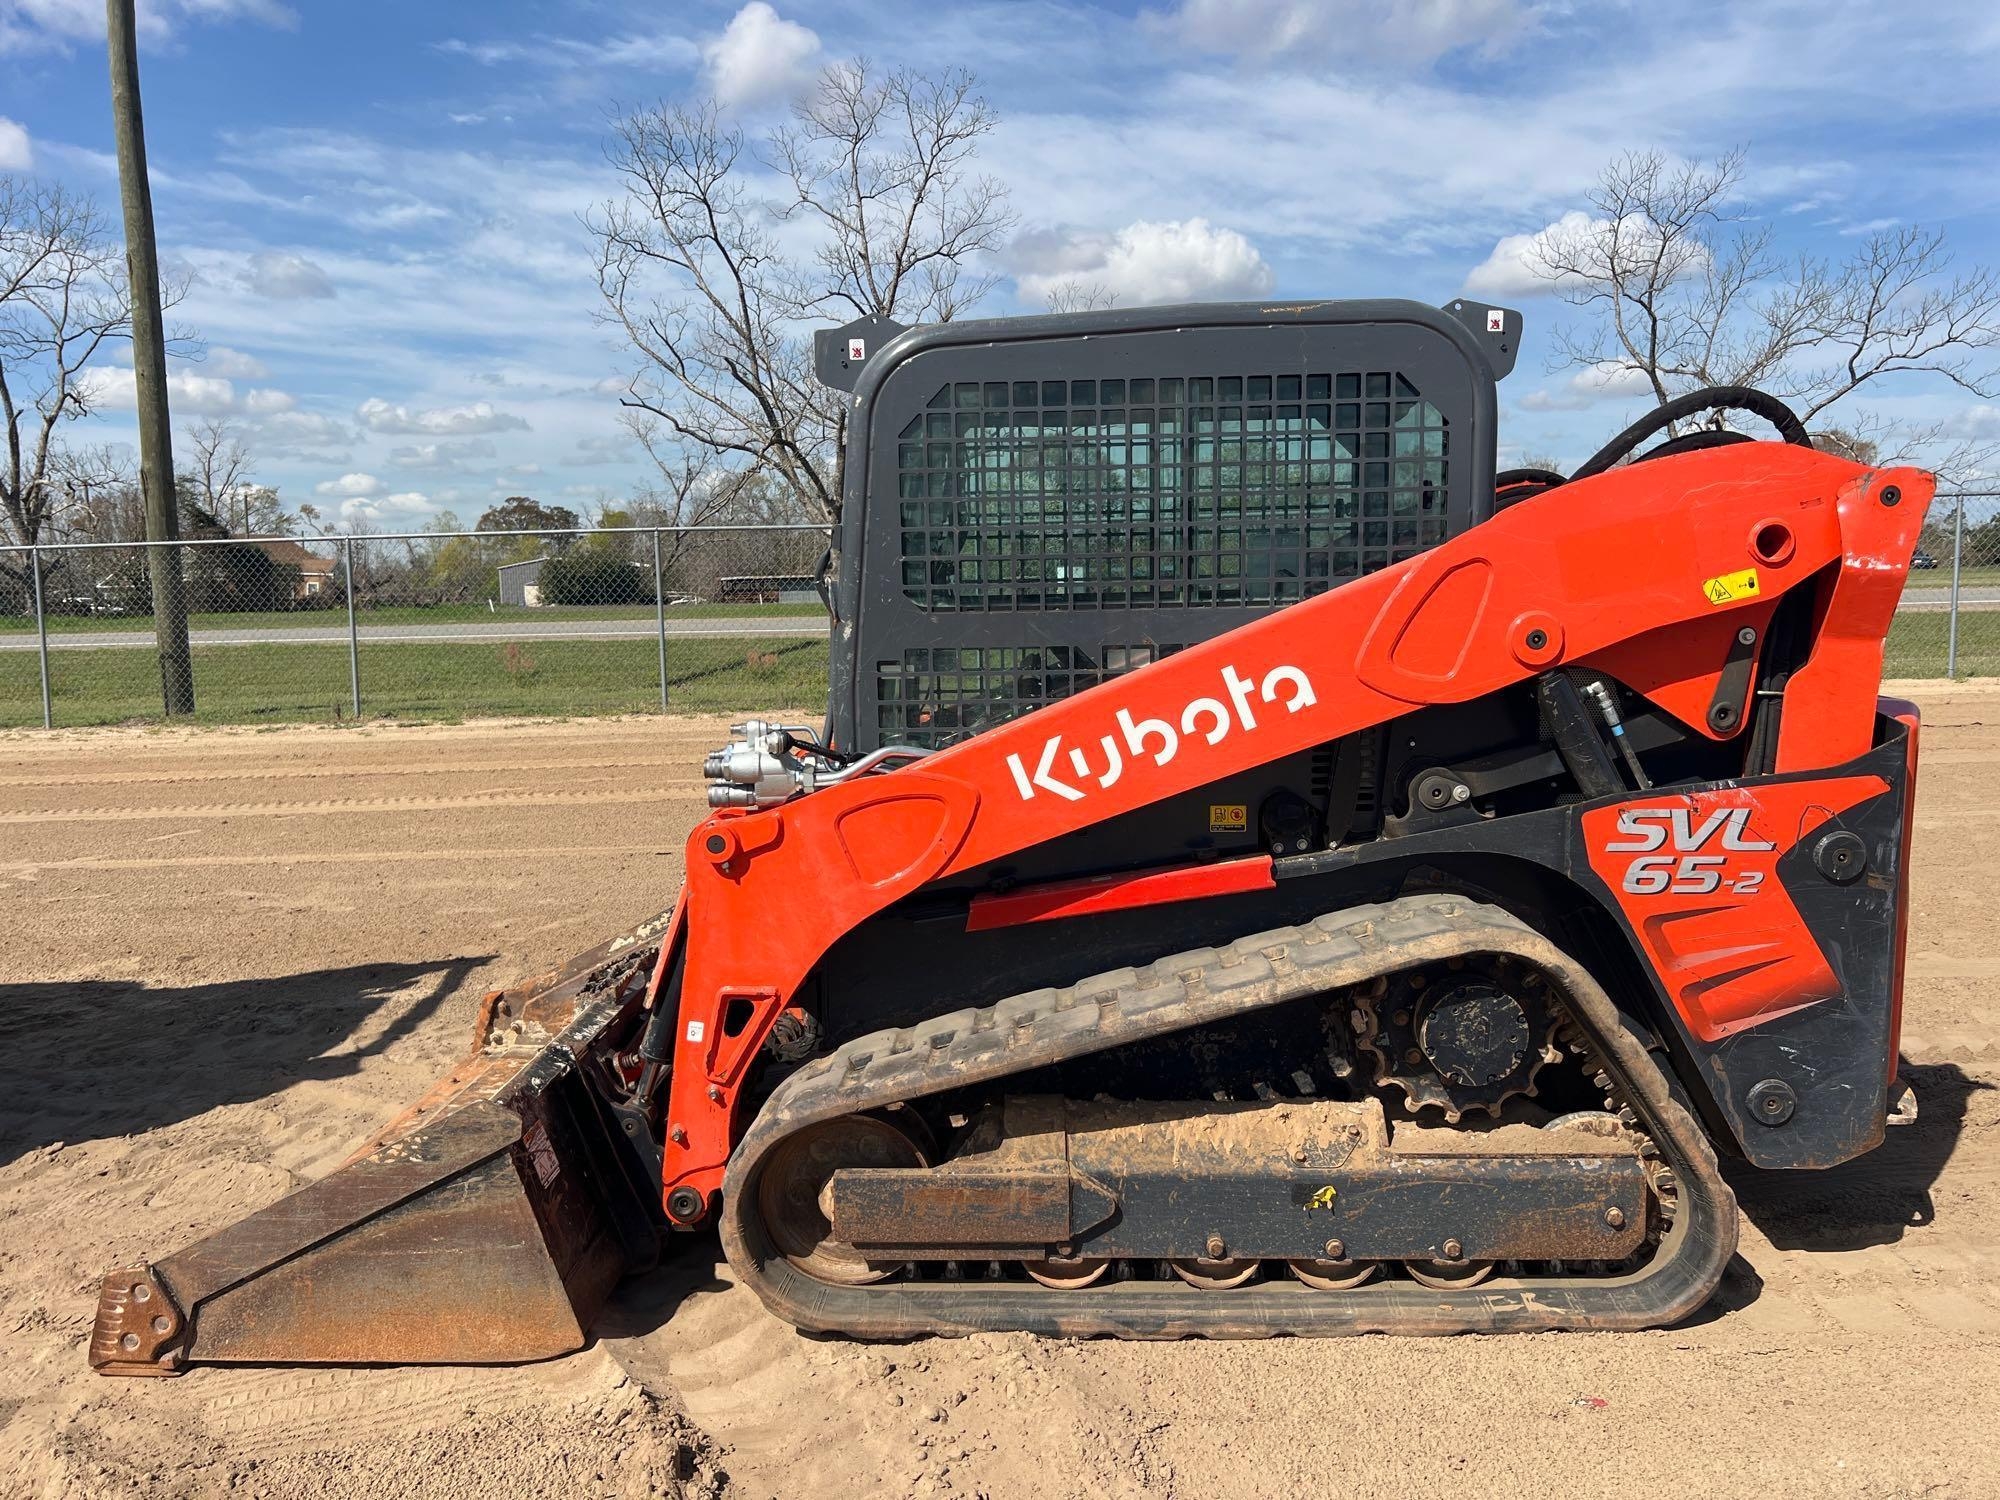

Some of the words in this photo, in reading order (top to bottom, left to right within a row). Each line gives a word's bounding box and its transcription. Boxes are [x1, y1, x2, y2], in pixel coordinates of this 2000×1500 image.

[1006, 665, 1317, 801] Kubota
[1605, 808, 1777, 852] SVL
[1622, 856, 1764, 894] 65-2
